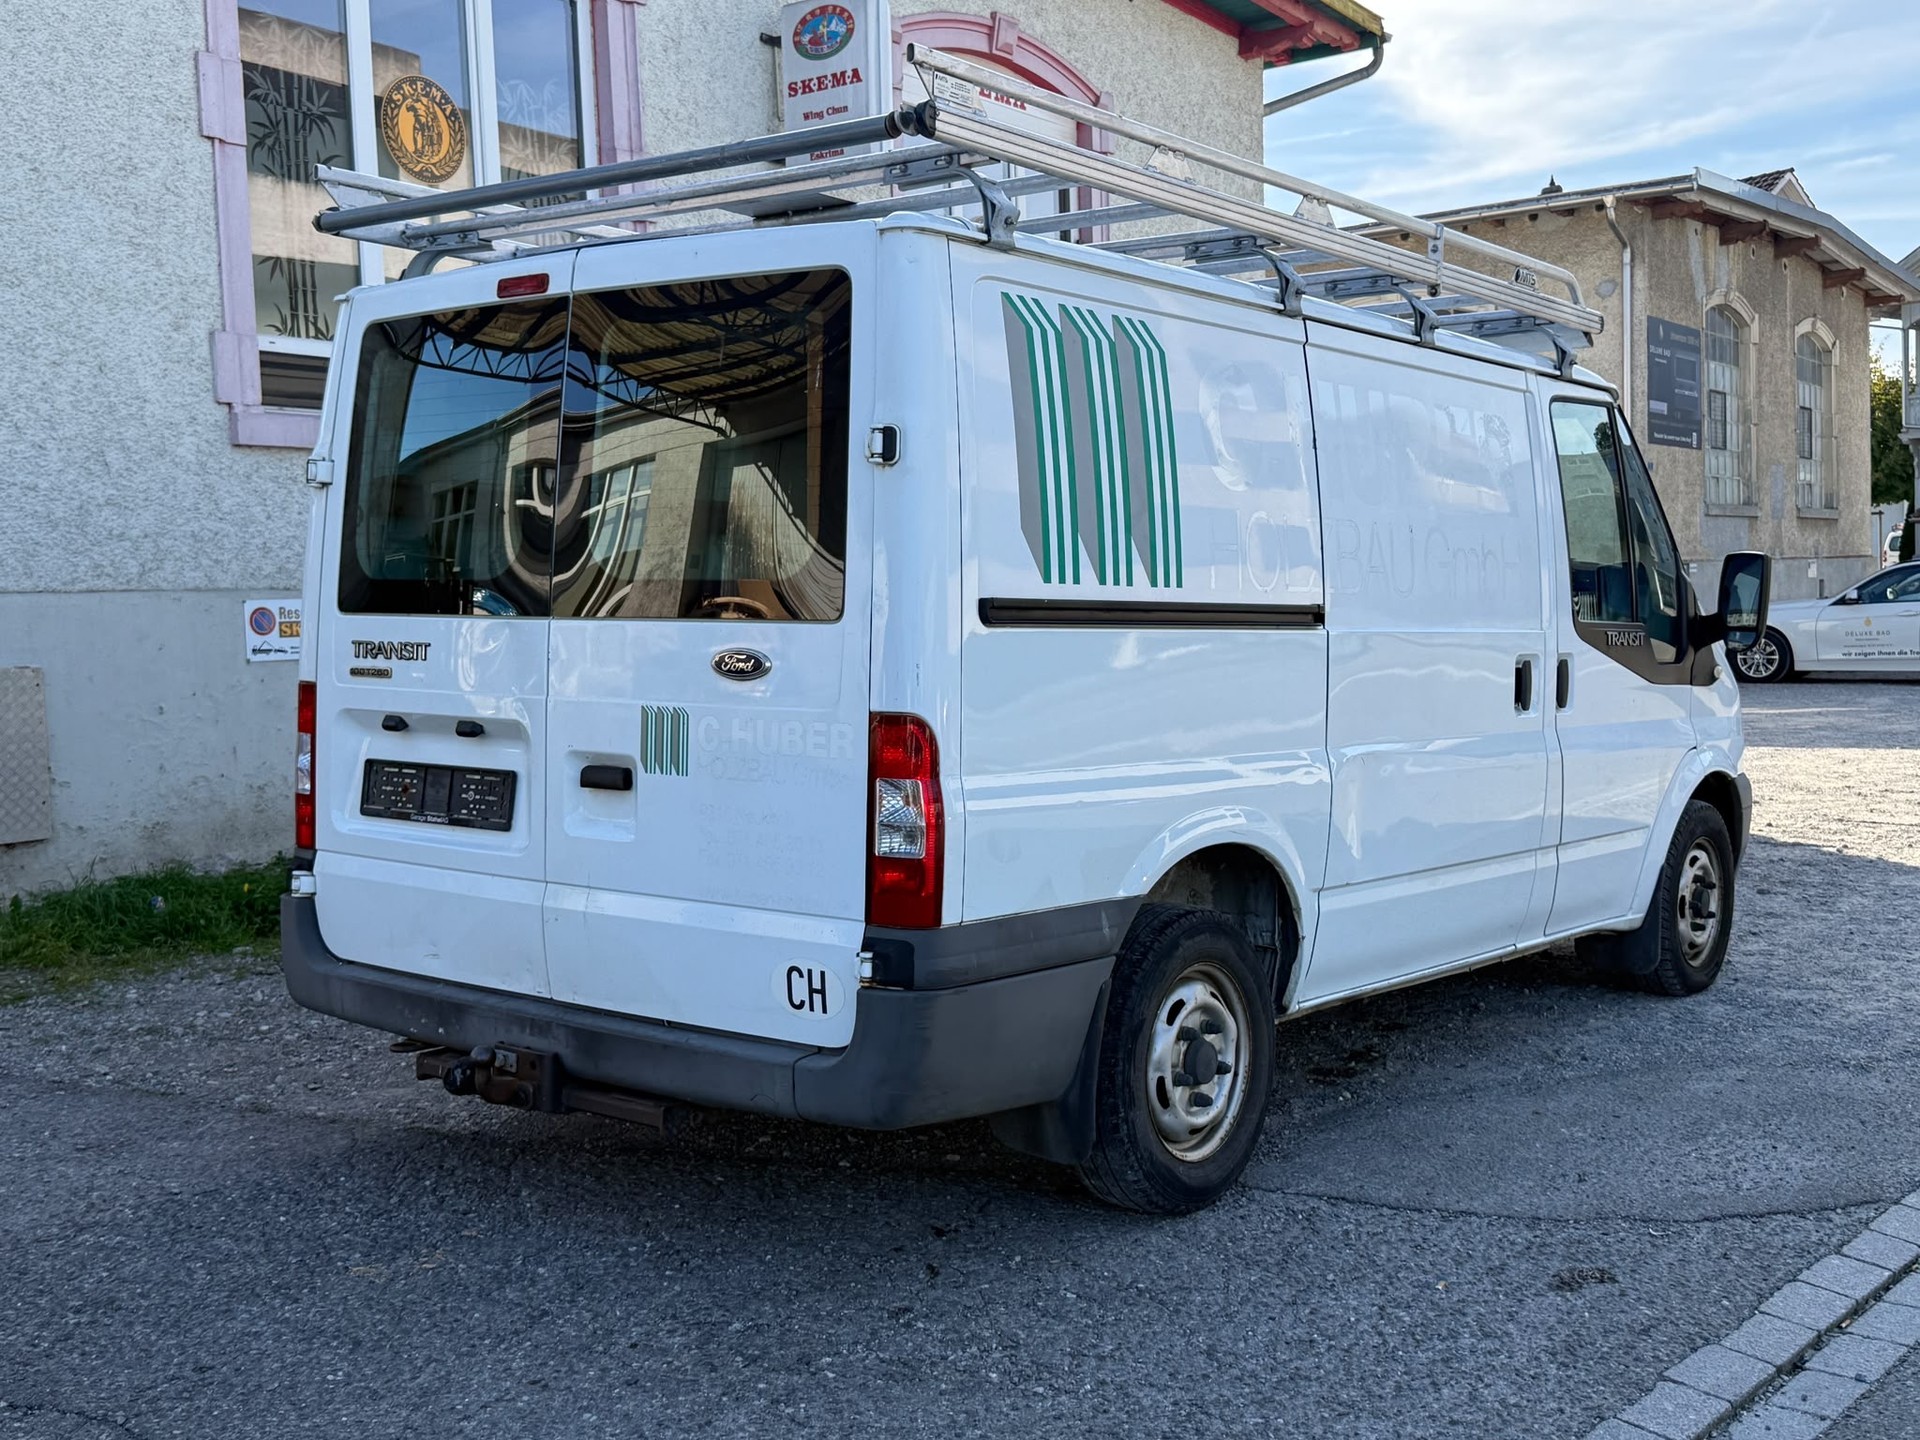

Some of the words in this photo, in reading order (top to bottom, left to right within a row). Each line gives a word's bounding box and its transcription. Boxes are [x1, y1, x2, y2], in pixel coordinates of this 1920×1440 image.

[803, 110, 825, 121] Wing
[826, 105, 849, 116] Chun
[810, 148, 845, 161] Eskrima
[1605, 631, 1646, 647] TRANSIT
[351, 640, 431, 661] TRANSIT
[1854, 650, 1876, 658] zeigen
[721, 654, 755, 672] Ford
[786, 965, 828, 1015] CH
